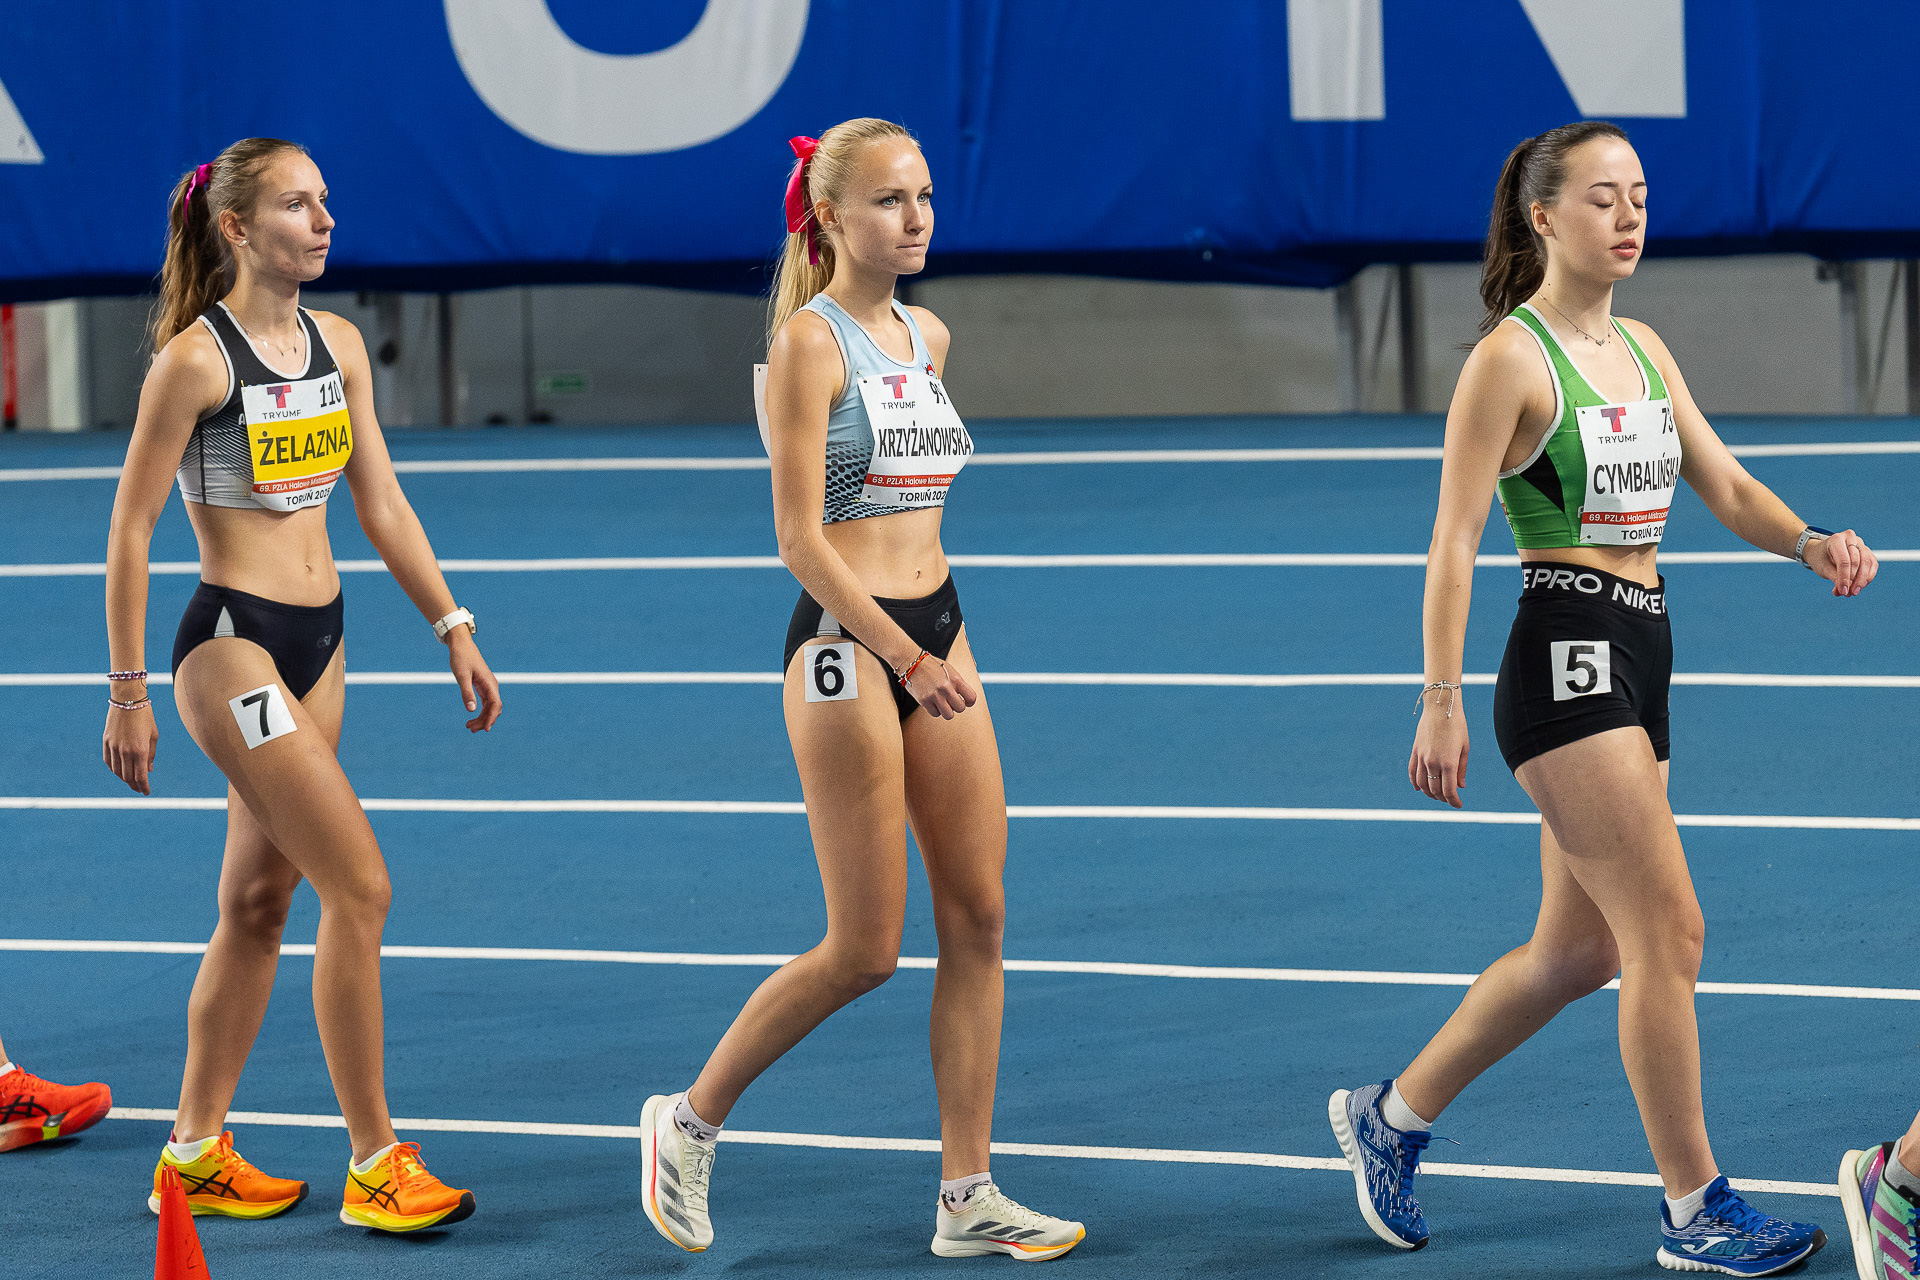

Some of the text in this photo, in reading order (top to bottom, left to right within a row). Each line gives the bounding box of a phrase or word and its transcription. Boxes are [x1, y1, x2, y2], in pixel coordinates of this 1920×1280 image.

[319, 379, 342, 408] 110
[881, 401, 916, 410] TRYUMF
[262, 409, 302, 420] TRYUMF
[257, 425, 350, 467] ŻELAZNA
[878, 420, 972, 458] KRZYŻANOWSKA
[1597, 434, 1638, 445] TRYUMF
[259, 485, 271, 493] 69.
[272, 483, 288, 492] PZLA
[872, 476, 884, 485] 69.
[886, 477, 903, 486] PZLA
[899, 489, 932, 502] TORUŃ
[1588, 513, 1602, 522] 69.
[1604, 514, 1625, 523] PZLA
[1621, 524, 1652, 540] TORUŃ
[1531, 568, 1603, 594] PRO
[1611, 582, 1662, 615] NIKE
[814, 648, 845, 698] 6
[1565, 645, 1598, 694] 5
[240, 690, 271, 738] 7
